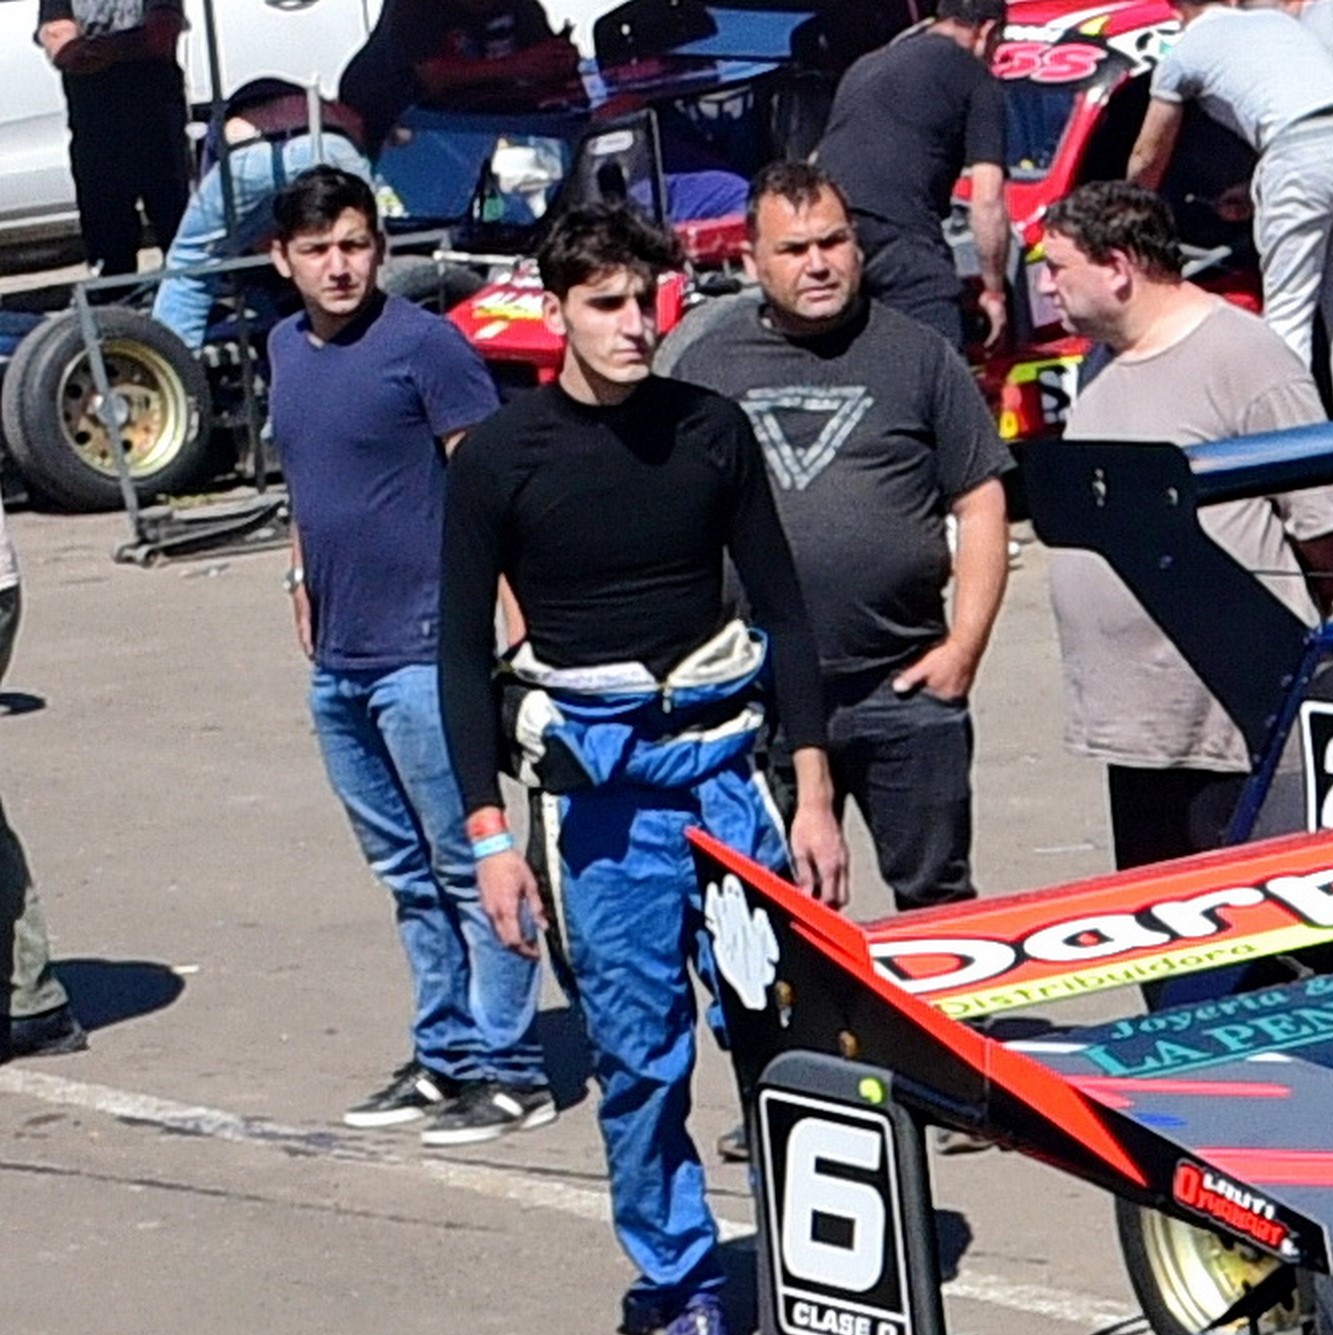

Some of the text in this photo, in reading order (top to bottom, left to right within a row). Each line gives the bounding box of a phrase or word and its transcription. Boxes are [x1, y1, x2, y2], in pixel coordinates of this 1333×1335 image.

[934, 945, 1256, 1018] Distribuidora
[1086, 1040, 1212, 1077] LA
[782, 1116, 887, 1293] 6
